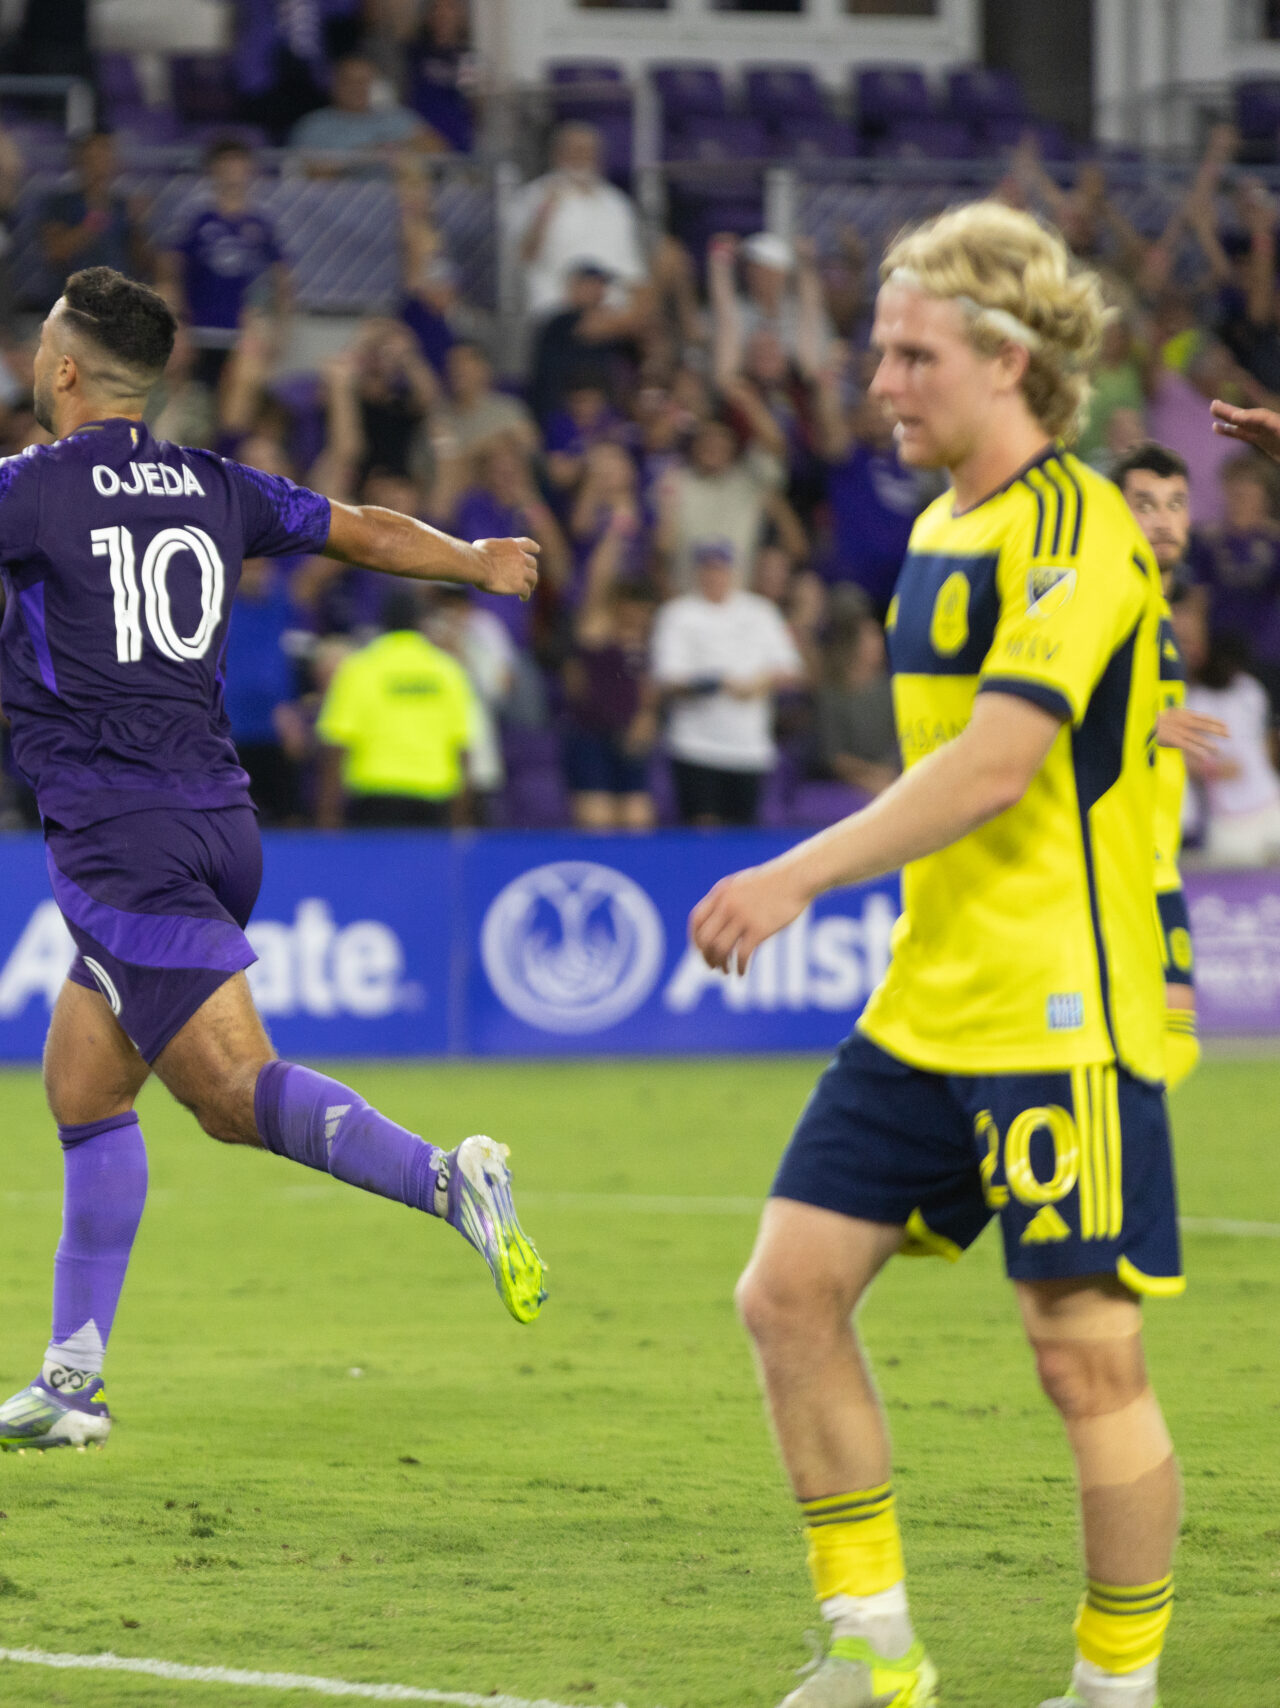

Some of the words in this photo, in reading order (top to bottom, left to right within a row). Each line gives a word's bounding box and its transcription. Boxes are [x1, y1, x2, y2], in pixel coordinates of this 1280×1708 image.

[91, 461, 206, 497] OJEDA
[90, 524, 225, 663] 10
[665, 892, 898, 1014] Allst
